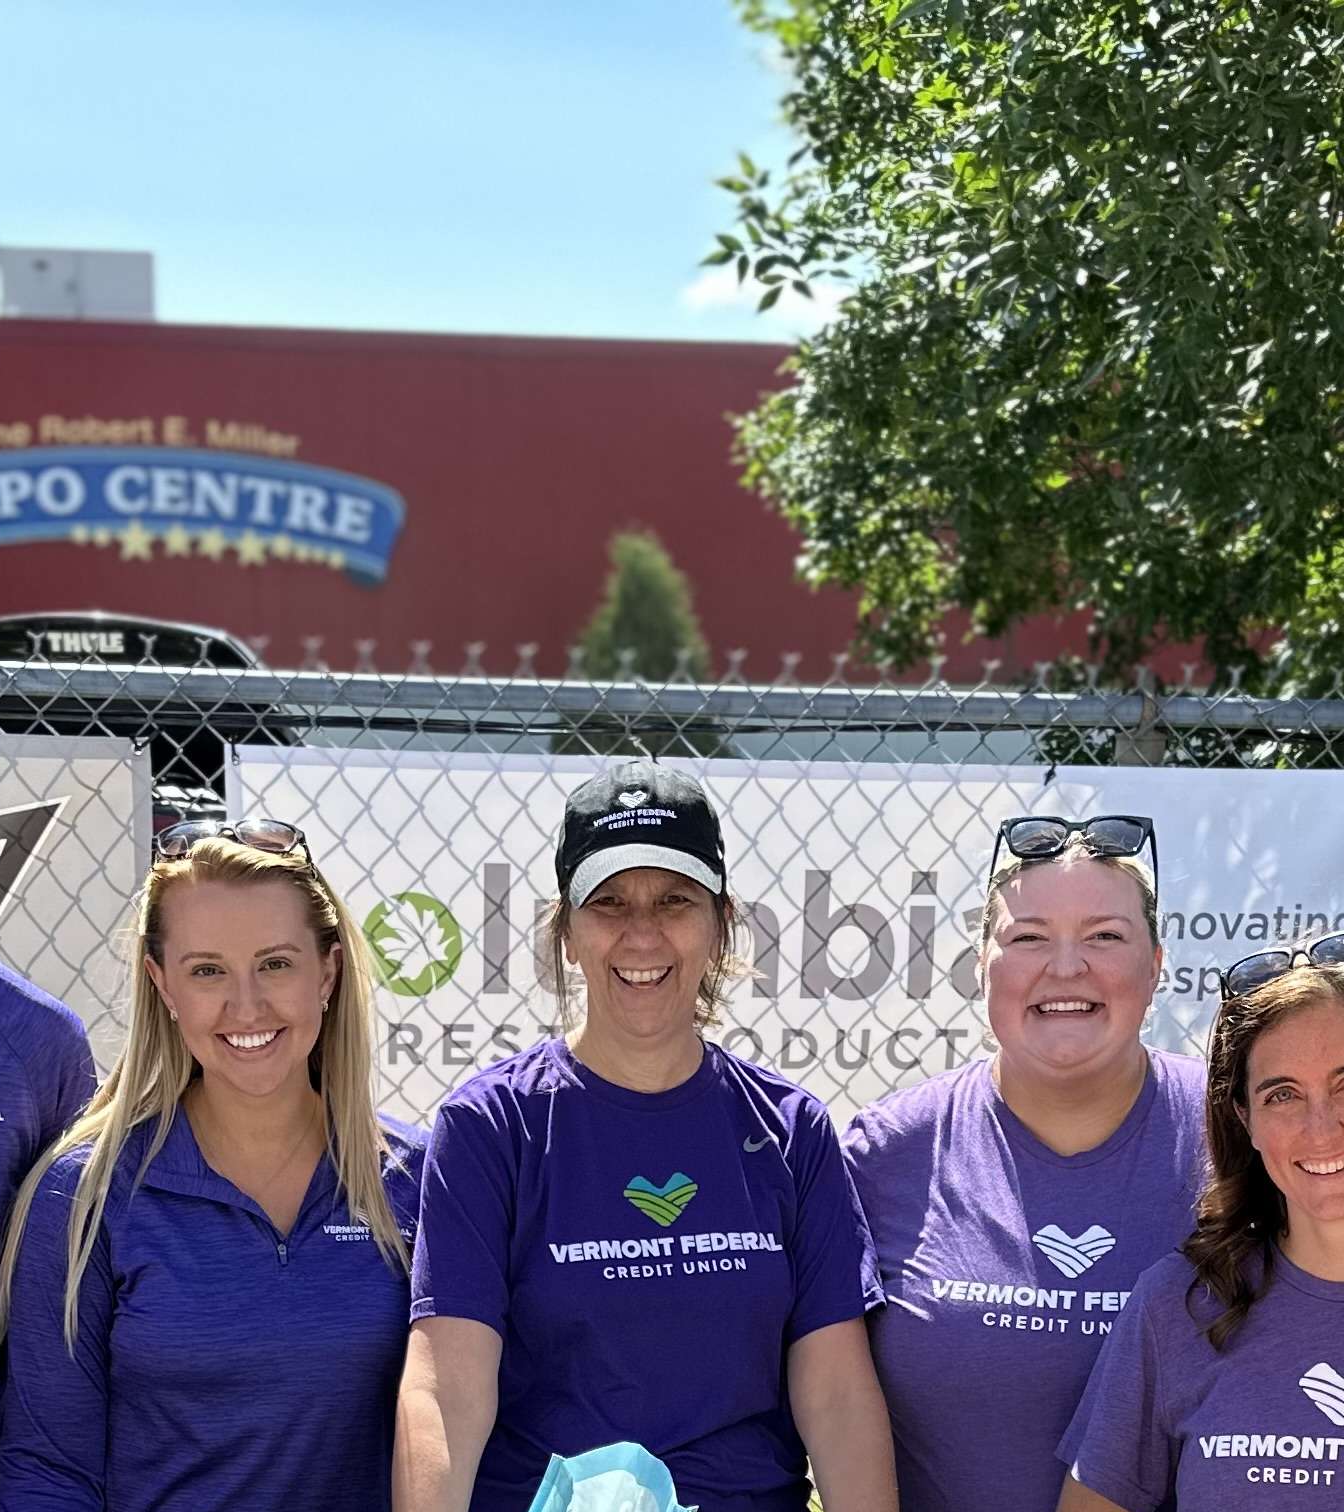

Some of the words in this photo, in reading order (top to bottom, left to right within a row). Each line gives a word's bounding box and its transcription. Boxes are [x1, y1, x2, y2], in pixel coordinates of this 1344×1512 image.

[38, 415, 155, 445] Robert
[162, 416, 198, 447] E.
[204, 420, 301, 456] Miller
[103, 464, 375, 544] CENTRE
[46, 631, 126, 656] THULE
[323, 1225, 371, 1235] VERMONT
[335, 1234, 370, 1242] CREDIT
[549, 1236, 678, 1264] VERMONT
[680, 1230, 783, 1258] FEDERAL
[603, 1262, 680, 1281] CREDIT
[683, 1256, 748, 1275] UNION
[931, 1279, 1079, 1313] VERMONT
[981, 1311, 1070, 1334] CREDIT
[1199, 1434, 1344, 1460] VERMONT
[1246, 1466, 1335, 1486] CREDIT
